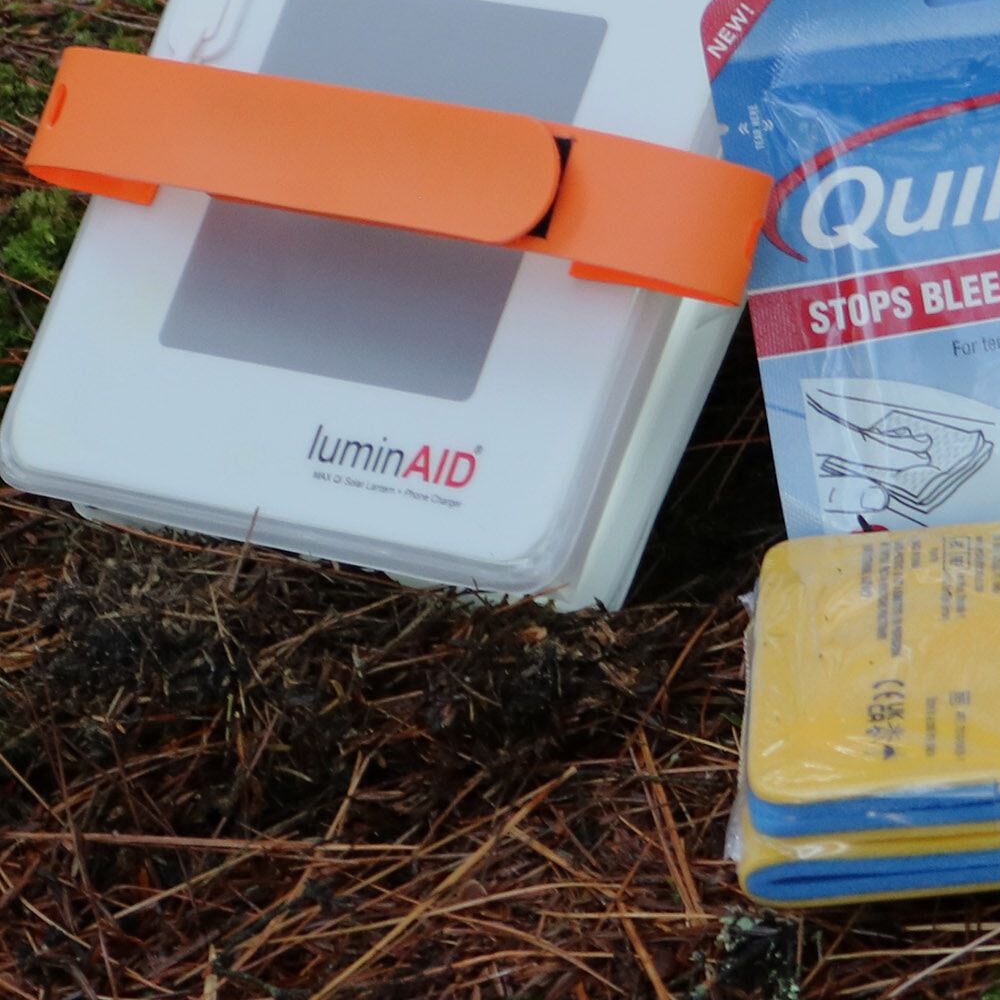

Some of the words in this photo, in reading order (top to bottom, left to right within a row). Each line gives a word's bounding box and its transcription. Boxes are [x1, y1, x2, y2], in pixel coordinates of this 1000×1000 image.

[706, 2, 755, 60] NEW!
[808, 286, 913, 335] STOPS
[952, 339, 978, 357] For
